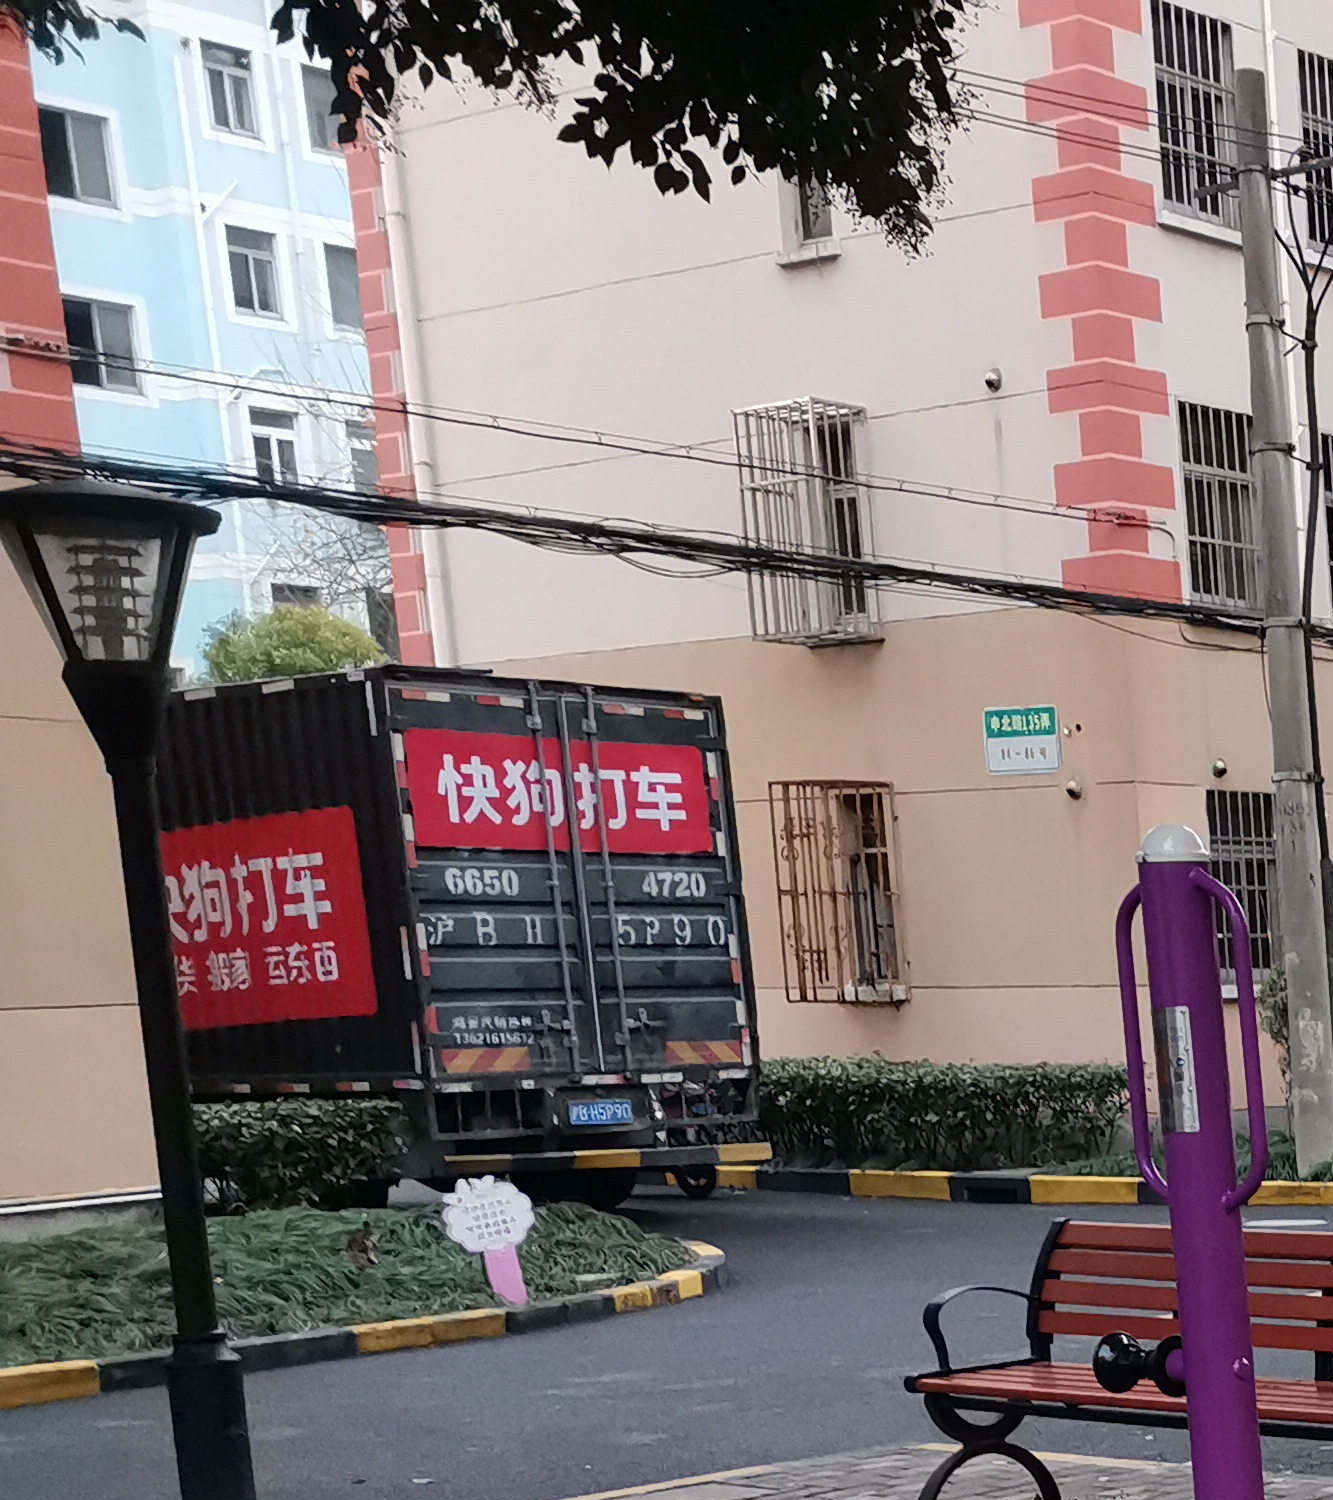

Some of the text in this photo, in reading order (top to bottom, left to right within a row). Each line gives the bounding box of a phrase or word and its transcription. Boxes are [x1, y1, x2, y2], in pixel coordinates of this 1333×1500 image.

[437, 753, 687, 831] 快狗打车
[444, 867, 519, 897] 6650
[641, 871, 706, 898] 4720
